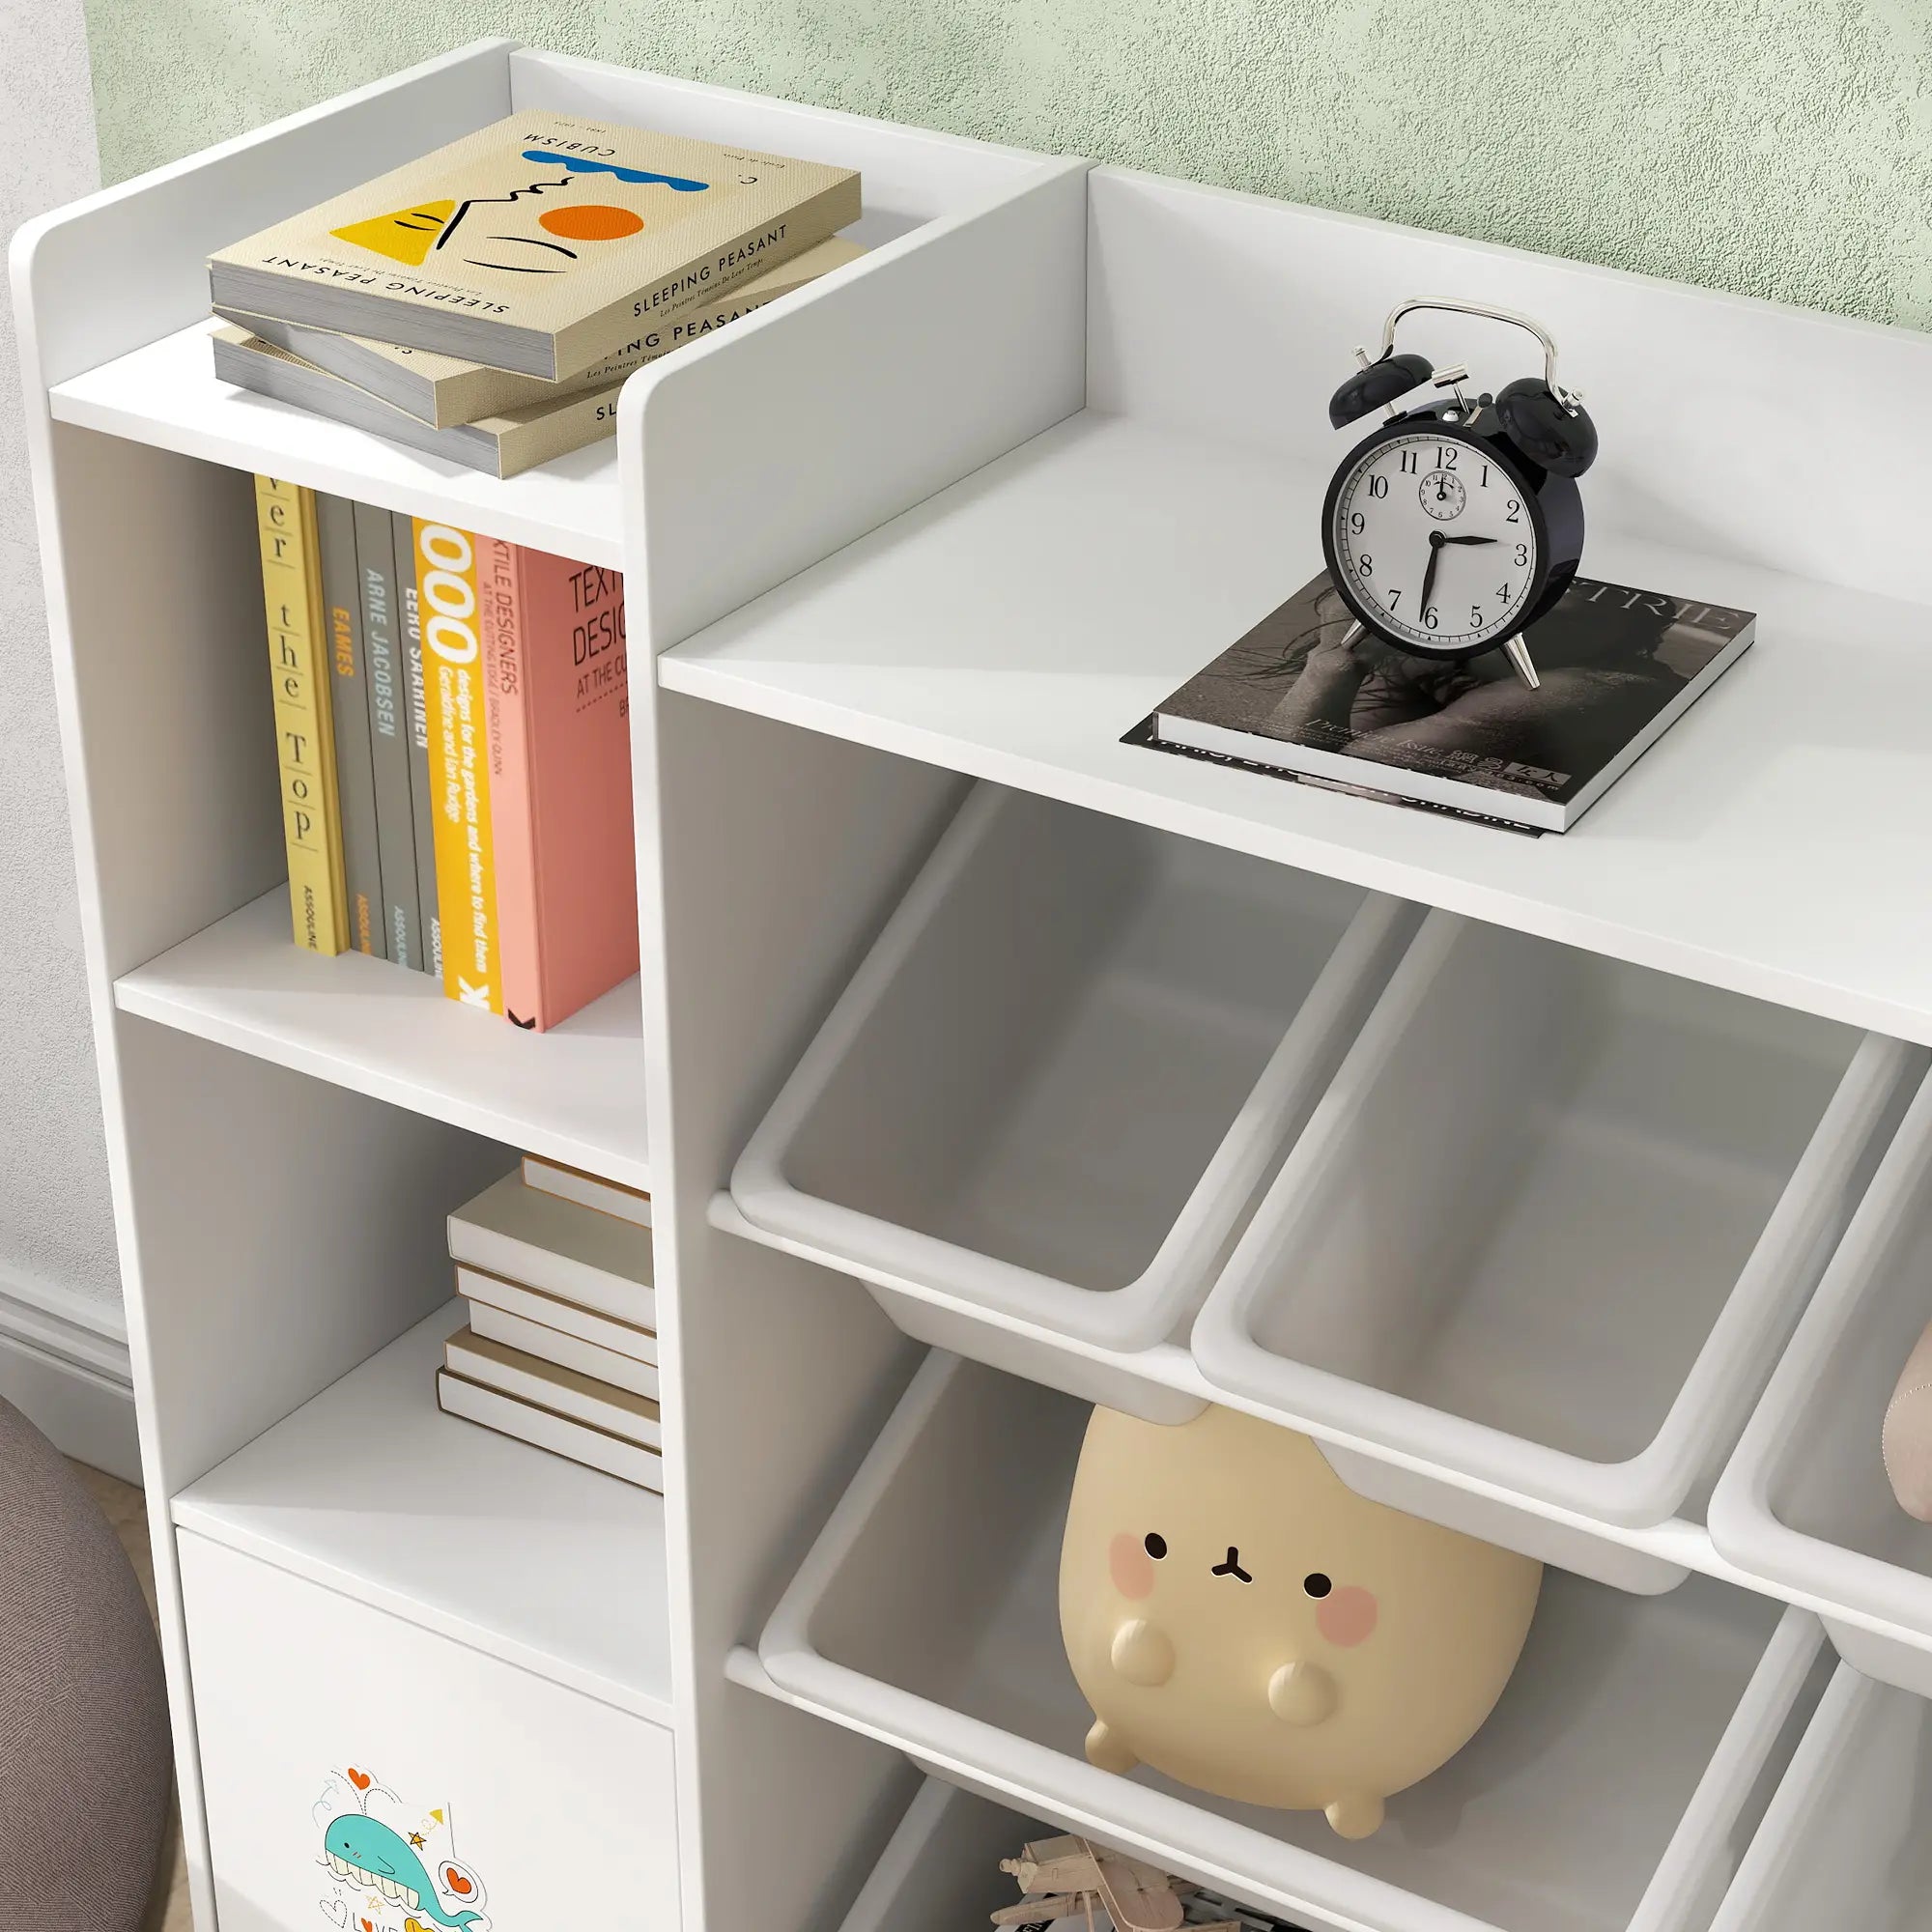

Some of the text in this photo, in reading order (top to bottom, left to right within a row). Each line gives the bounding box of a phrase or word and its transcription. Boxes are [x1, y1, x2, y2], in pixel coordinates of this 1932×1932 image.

[524, 133, 615, 156] CUBISM
[634, 224, 786, 318] SLEEPING PEASANT
[262, 256, 510, 313] SLEEPING PEASANT
[1400, 450, 1417, 474] 11
[1435, 446, 1458, 470] 12
[1368, 474, 1388, 498] 10
[1480, 465, 1489, 488] 1
[1506, 499, 1520, 523] 2
[1351, 512, 1365, 535] 9
[1359, 554, 1373, 577] 8
[1514, 543, 1527, 566] 3
[1387, 589, 1402, 611] 7
[1495, 582, 1511, 604] 4
[1566, 580, 1739, 630] TRIE
[1424, 607, 1438, 629] 6
[1469, 605, 1483, 628] 5
[280, 604, 299, 698] the
[332, 606, 354, 677] EAMES
[366, 568, 395, 737] ARNE JACOBSEN
[497, 591, 518, 696] DESIGNERS
[577, 673, 589, 698] AT
[592, 661, 613, 690] THE
[442, 729, 459, 757] and
[456, 668, 490, 973] designs for the gardens and where to find them
